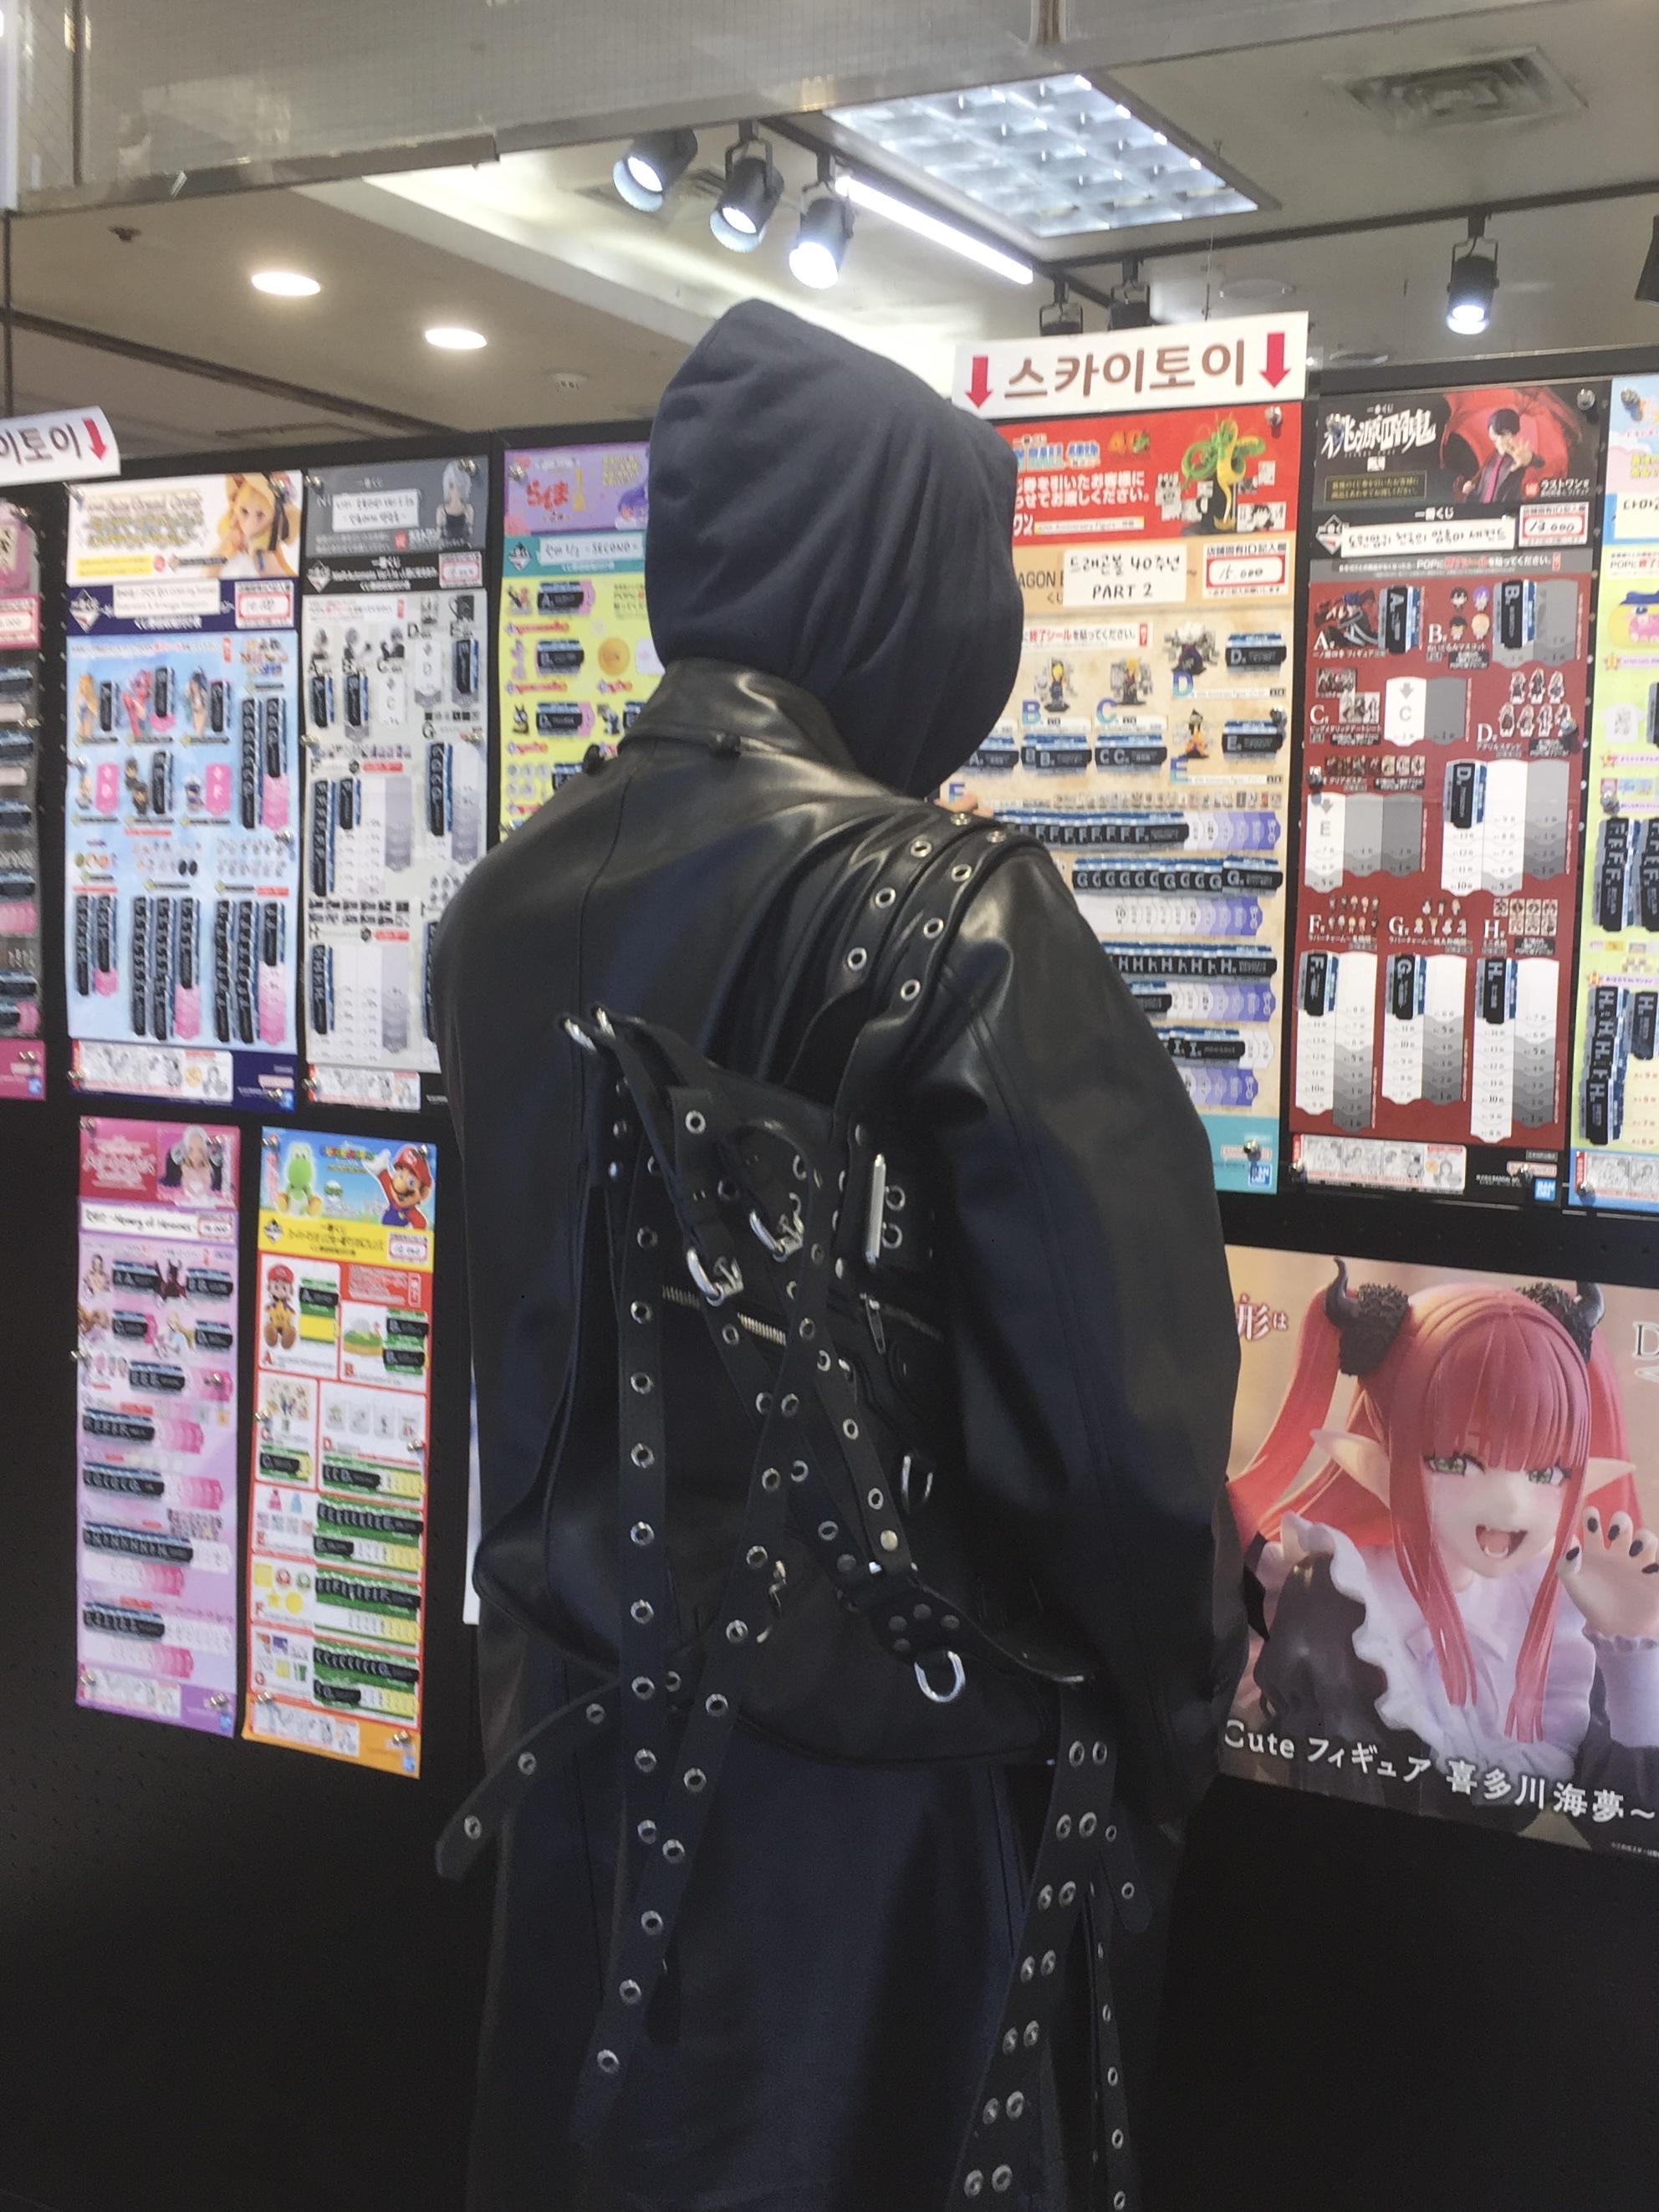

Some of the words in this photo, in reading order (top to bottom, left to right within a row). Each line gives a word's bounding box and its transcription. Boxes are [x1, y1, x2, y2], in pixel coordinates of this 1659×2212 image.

[1004, 339, 1245, 399] 스카이토이
[1069, 554, 1122, 576] 드래곤볼
[1131, 555, 1180, 573] 40주년
[1018, 571, 1055, 589] AGON
[1093, 585, 1135, 600] PART
[1143, 584, 1153, 597] 2
[1225, 1719, 1294, 1760] Cute
[1307, 1736, 1431, 1782] フィギュア
